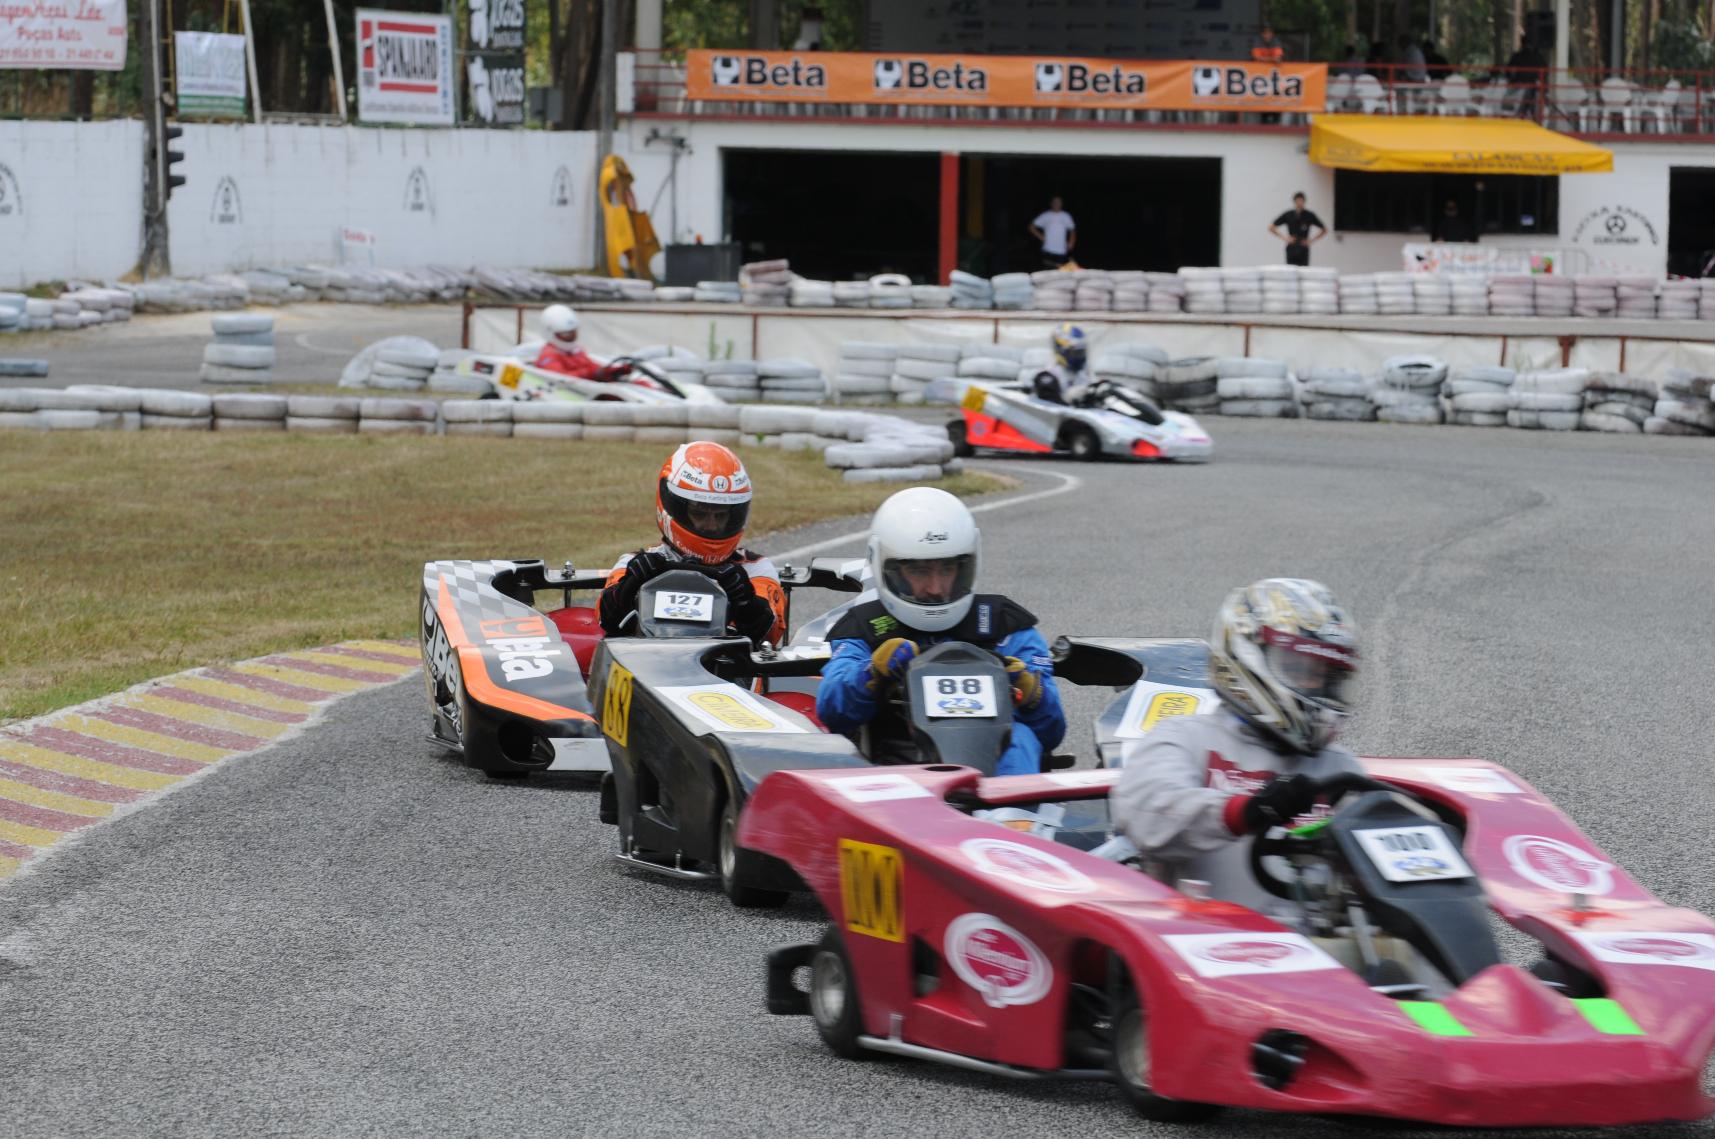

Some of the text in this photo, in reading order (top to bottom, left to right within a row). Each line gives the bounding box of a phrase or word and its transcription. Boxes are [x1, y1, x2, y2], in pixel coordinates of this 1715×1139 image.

[378, 35, 437, 80] SPANJAARD
[745, 58, 826, 88] Beta
[906, 61, 987, 91] Beta
[1067, 64, 1146, 94] Beta
[1225, 68, 1303, 97] Beta
[667, 594, 702, 606] 127
[485, 636, 562, 683] Beta
[937, 678, 982, 695] 88
